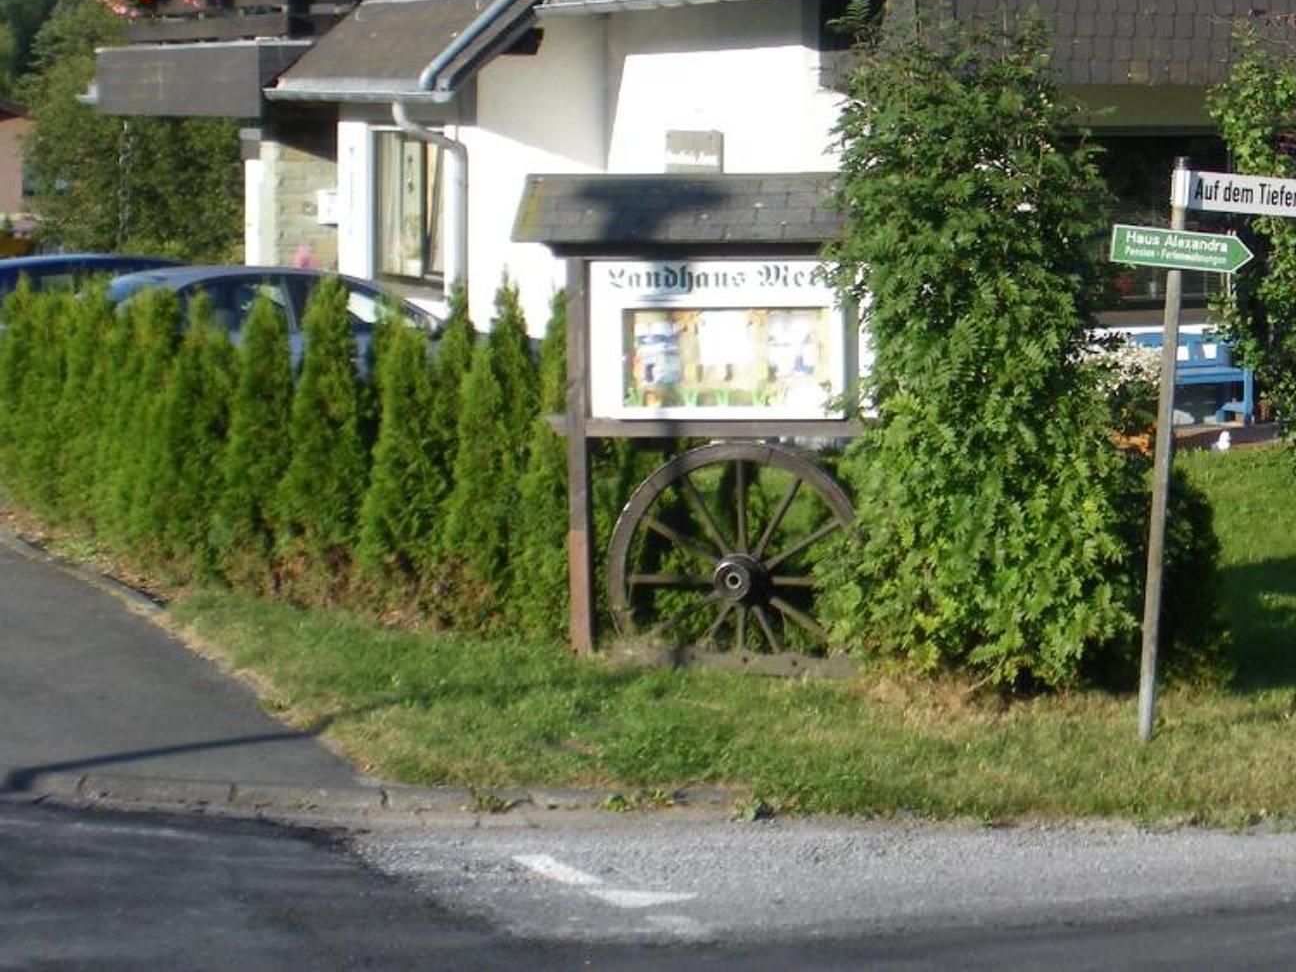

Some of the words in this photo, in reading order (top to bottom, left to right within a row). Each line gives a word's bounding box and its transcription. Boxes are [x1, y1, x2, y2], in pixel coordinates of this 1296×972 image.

[1194, 178, 1220, 201] Auf
[1223, 181, 1254, 204] dem
[1126, 230, 1160, 246] Haus
[1164, 234, 1228, 253] Alexandra
[608, 264, 746, 294] Landhaus
